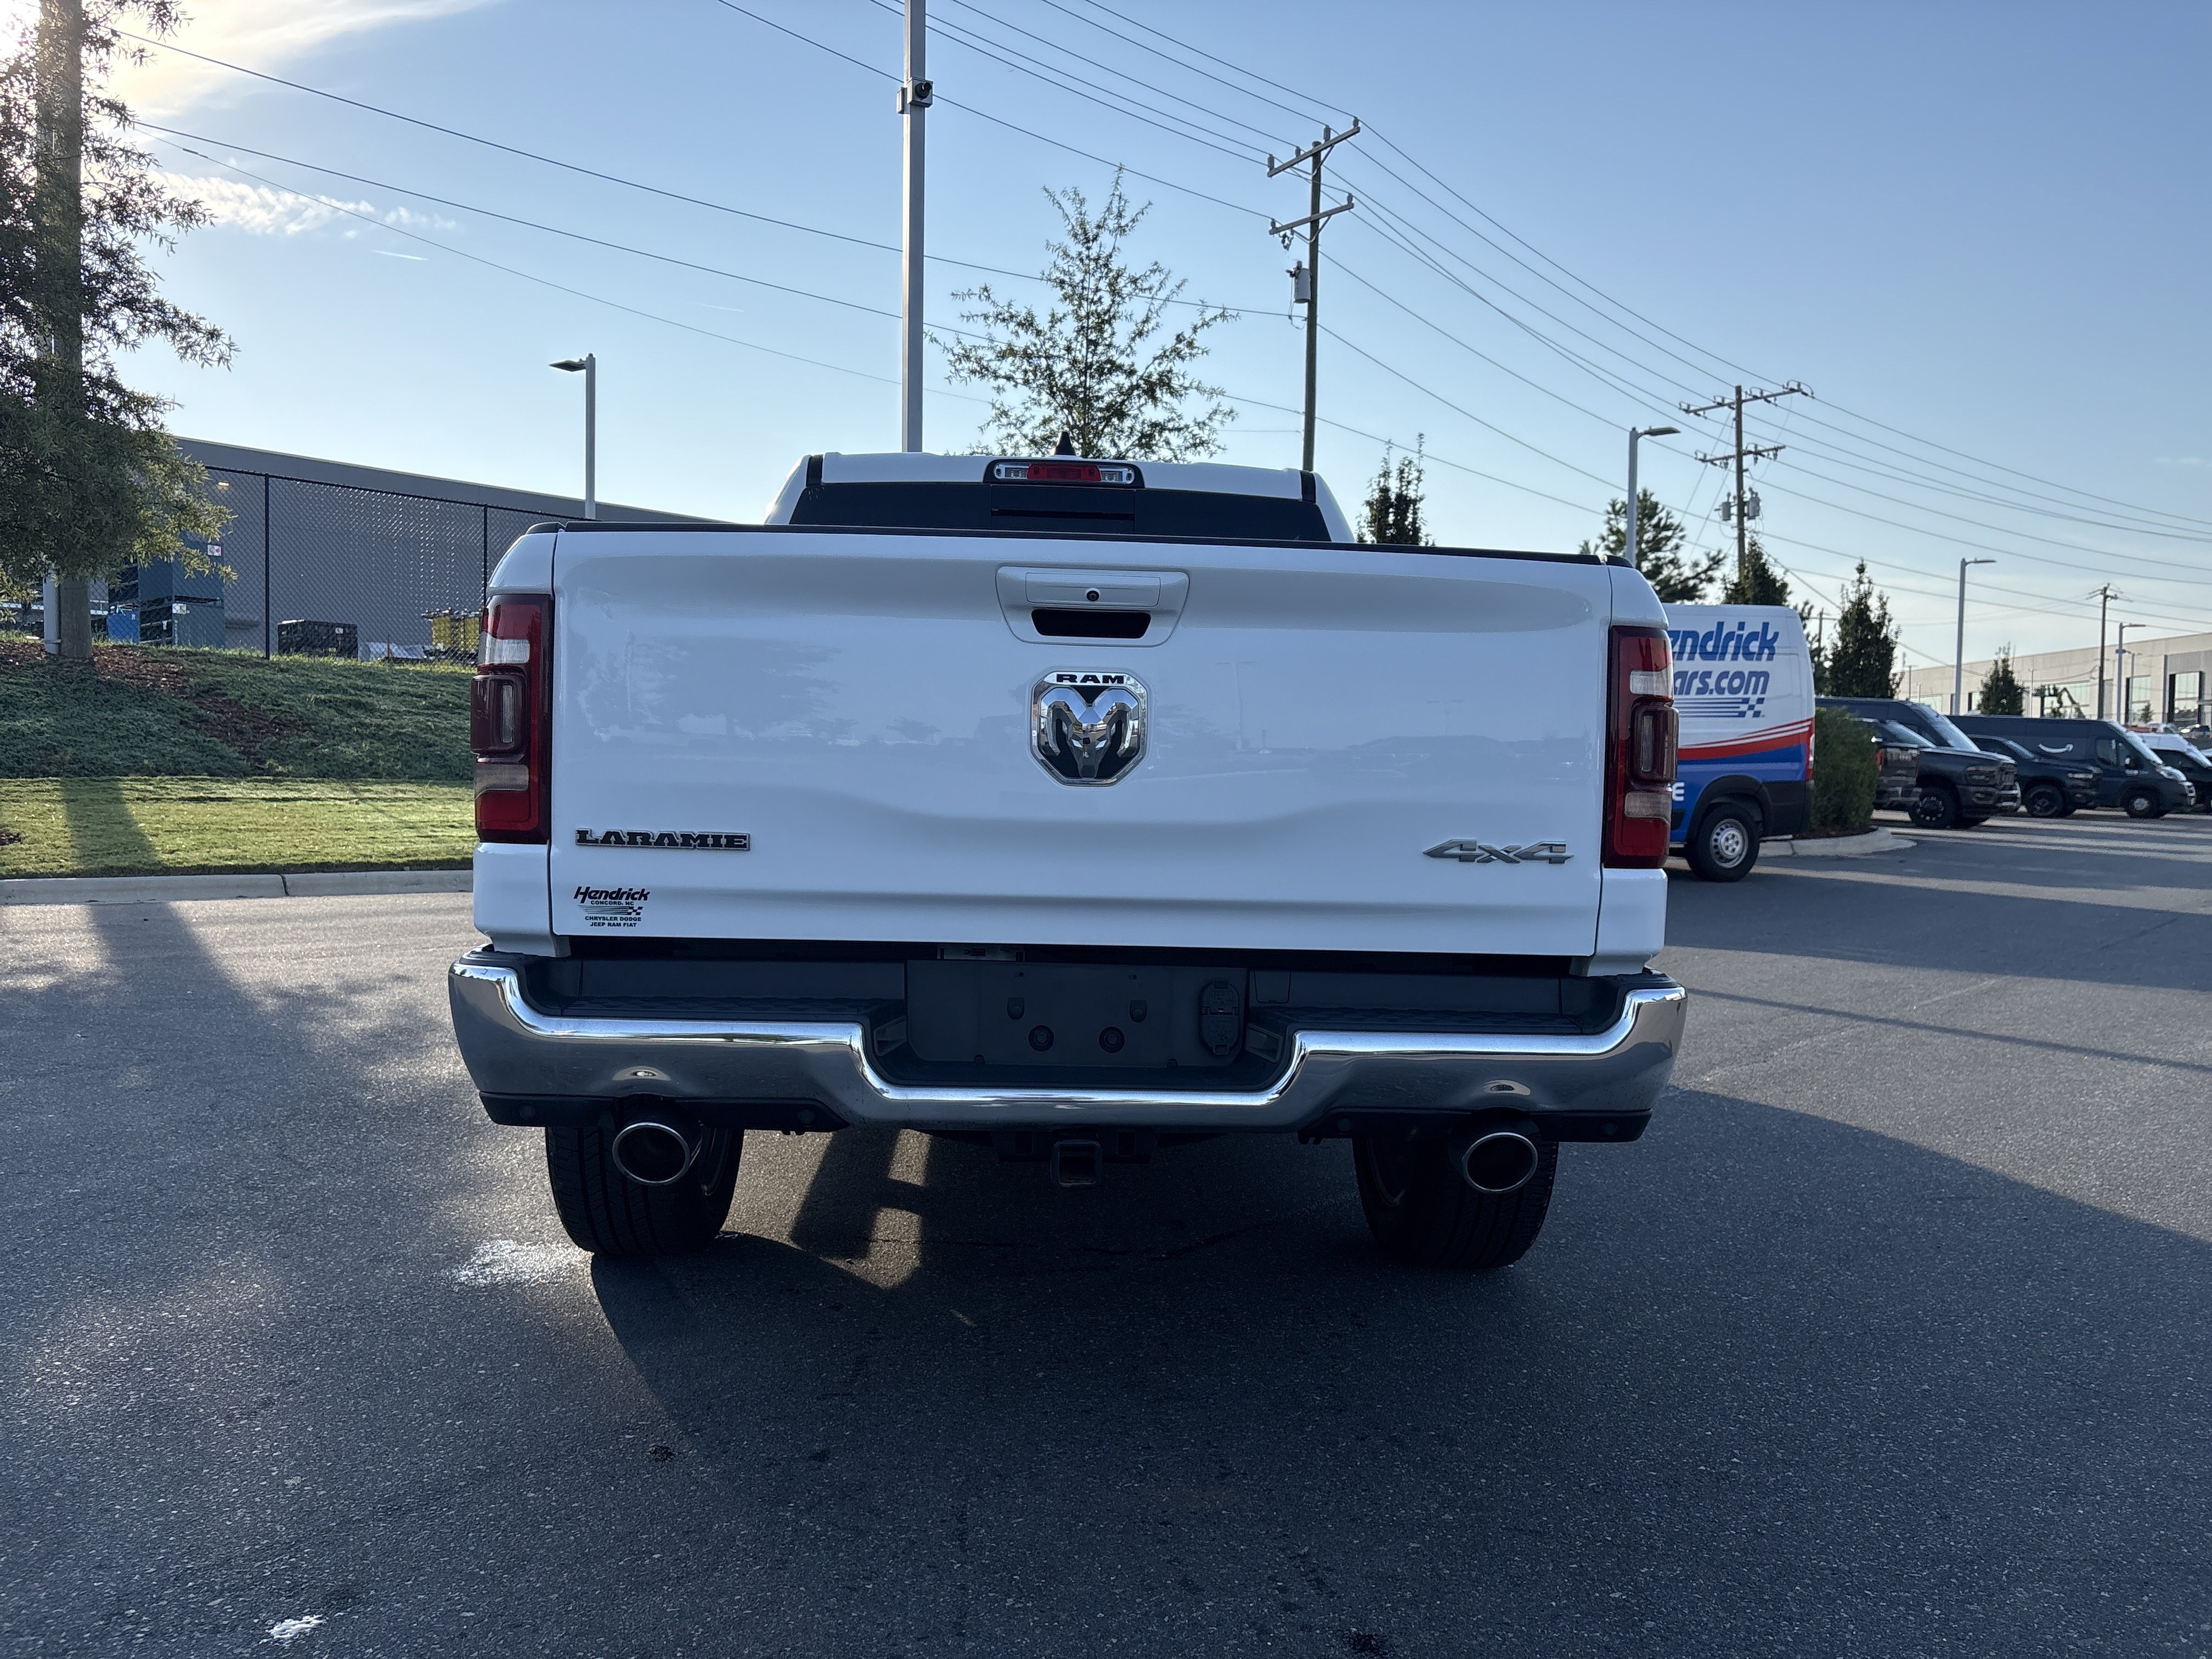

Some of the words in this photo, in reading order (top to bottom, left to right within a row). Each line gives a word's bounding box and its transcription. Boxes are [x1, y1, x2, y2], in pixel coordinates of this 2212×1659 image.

[1056, 673, 1125, 684] RAM
[575, 828, 751, 851] LARAMIE
[573, 886, 651, 904] Hendrick
